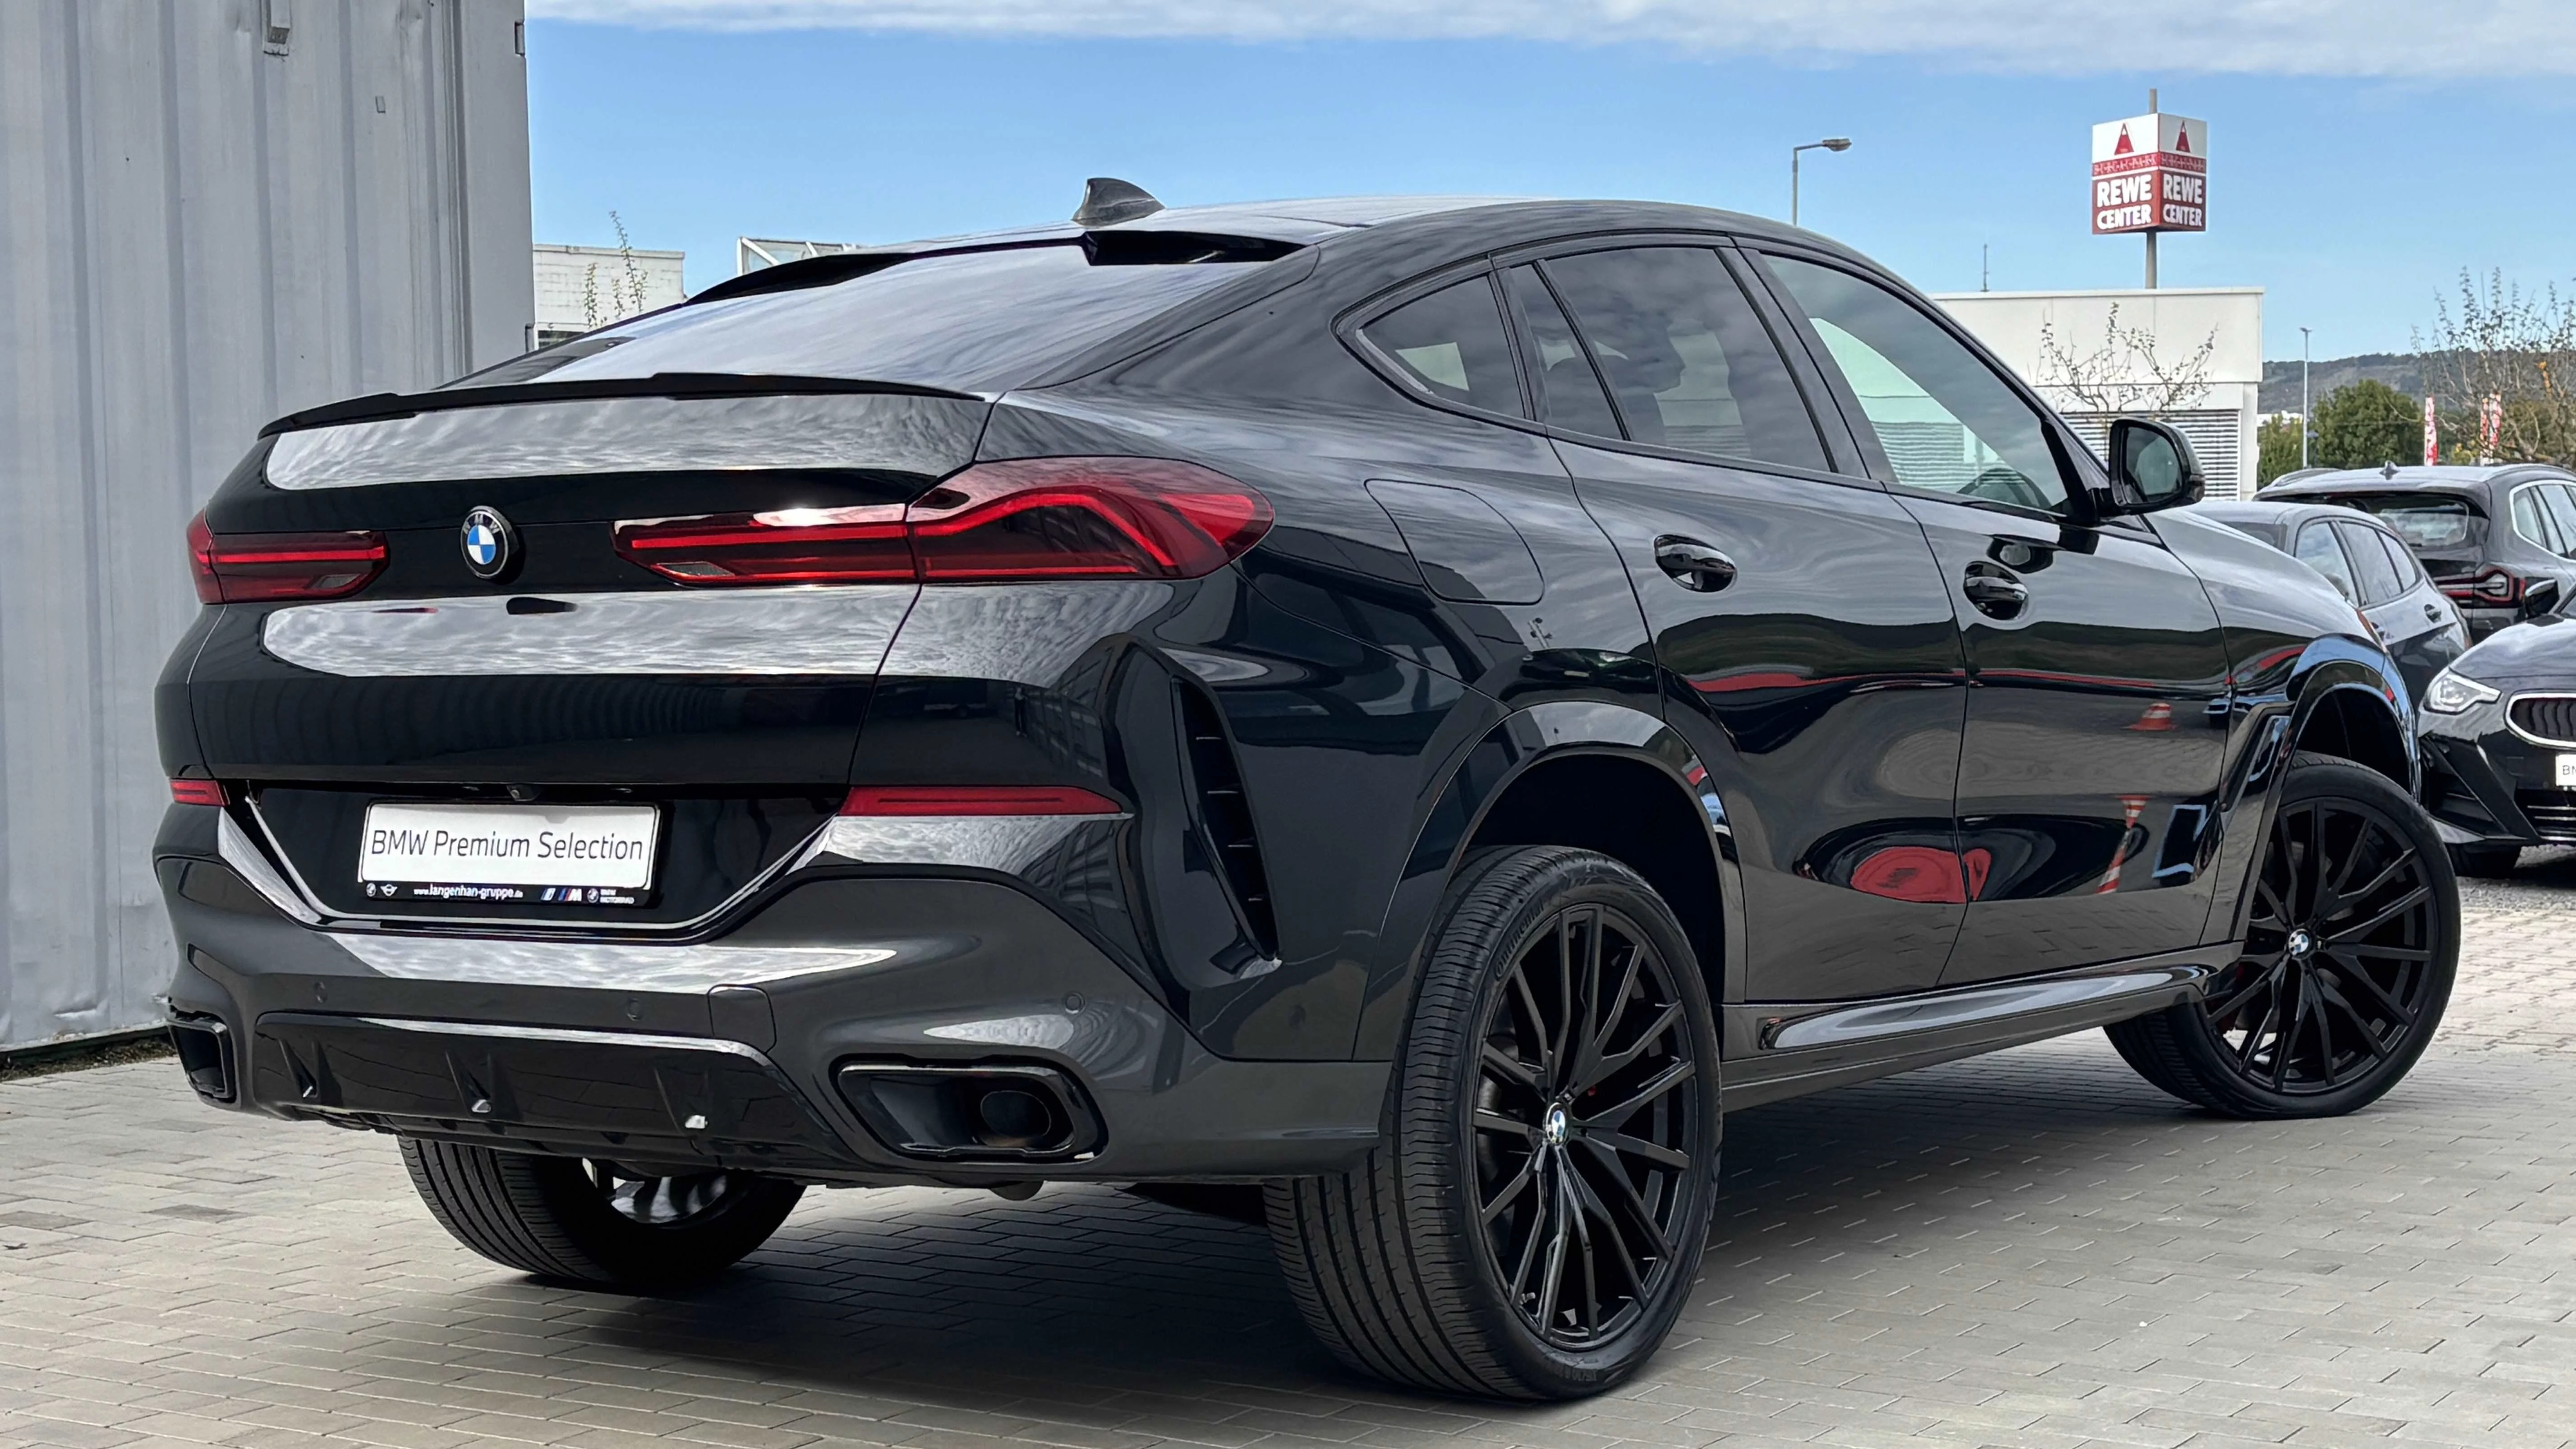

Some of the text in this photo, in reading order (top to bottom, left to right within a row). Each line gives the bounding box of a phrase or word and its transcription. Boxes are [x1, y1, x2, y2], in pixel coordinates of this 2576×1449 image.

[2097, 174, 2152, 207] REWE
[2163, 174, 2203, 204] REWE
[2097, 204, 2152, 230] CENTER
[2163, 204, 2202, 226] CENTER
[463, 513, 501, 534] BMW
[372, 829, 643, 860] BMW Premium Selection
